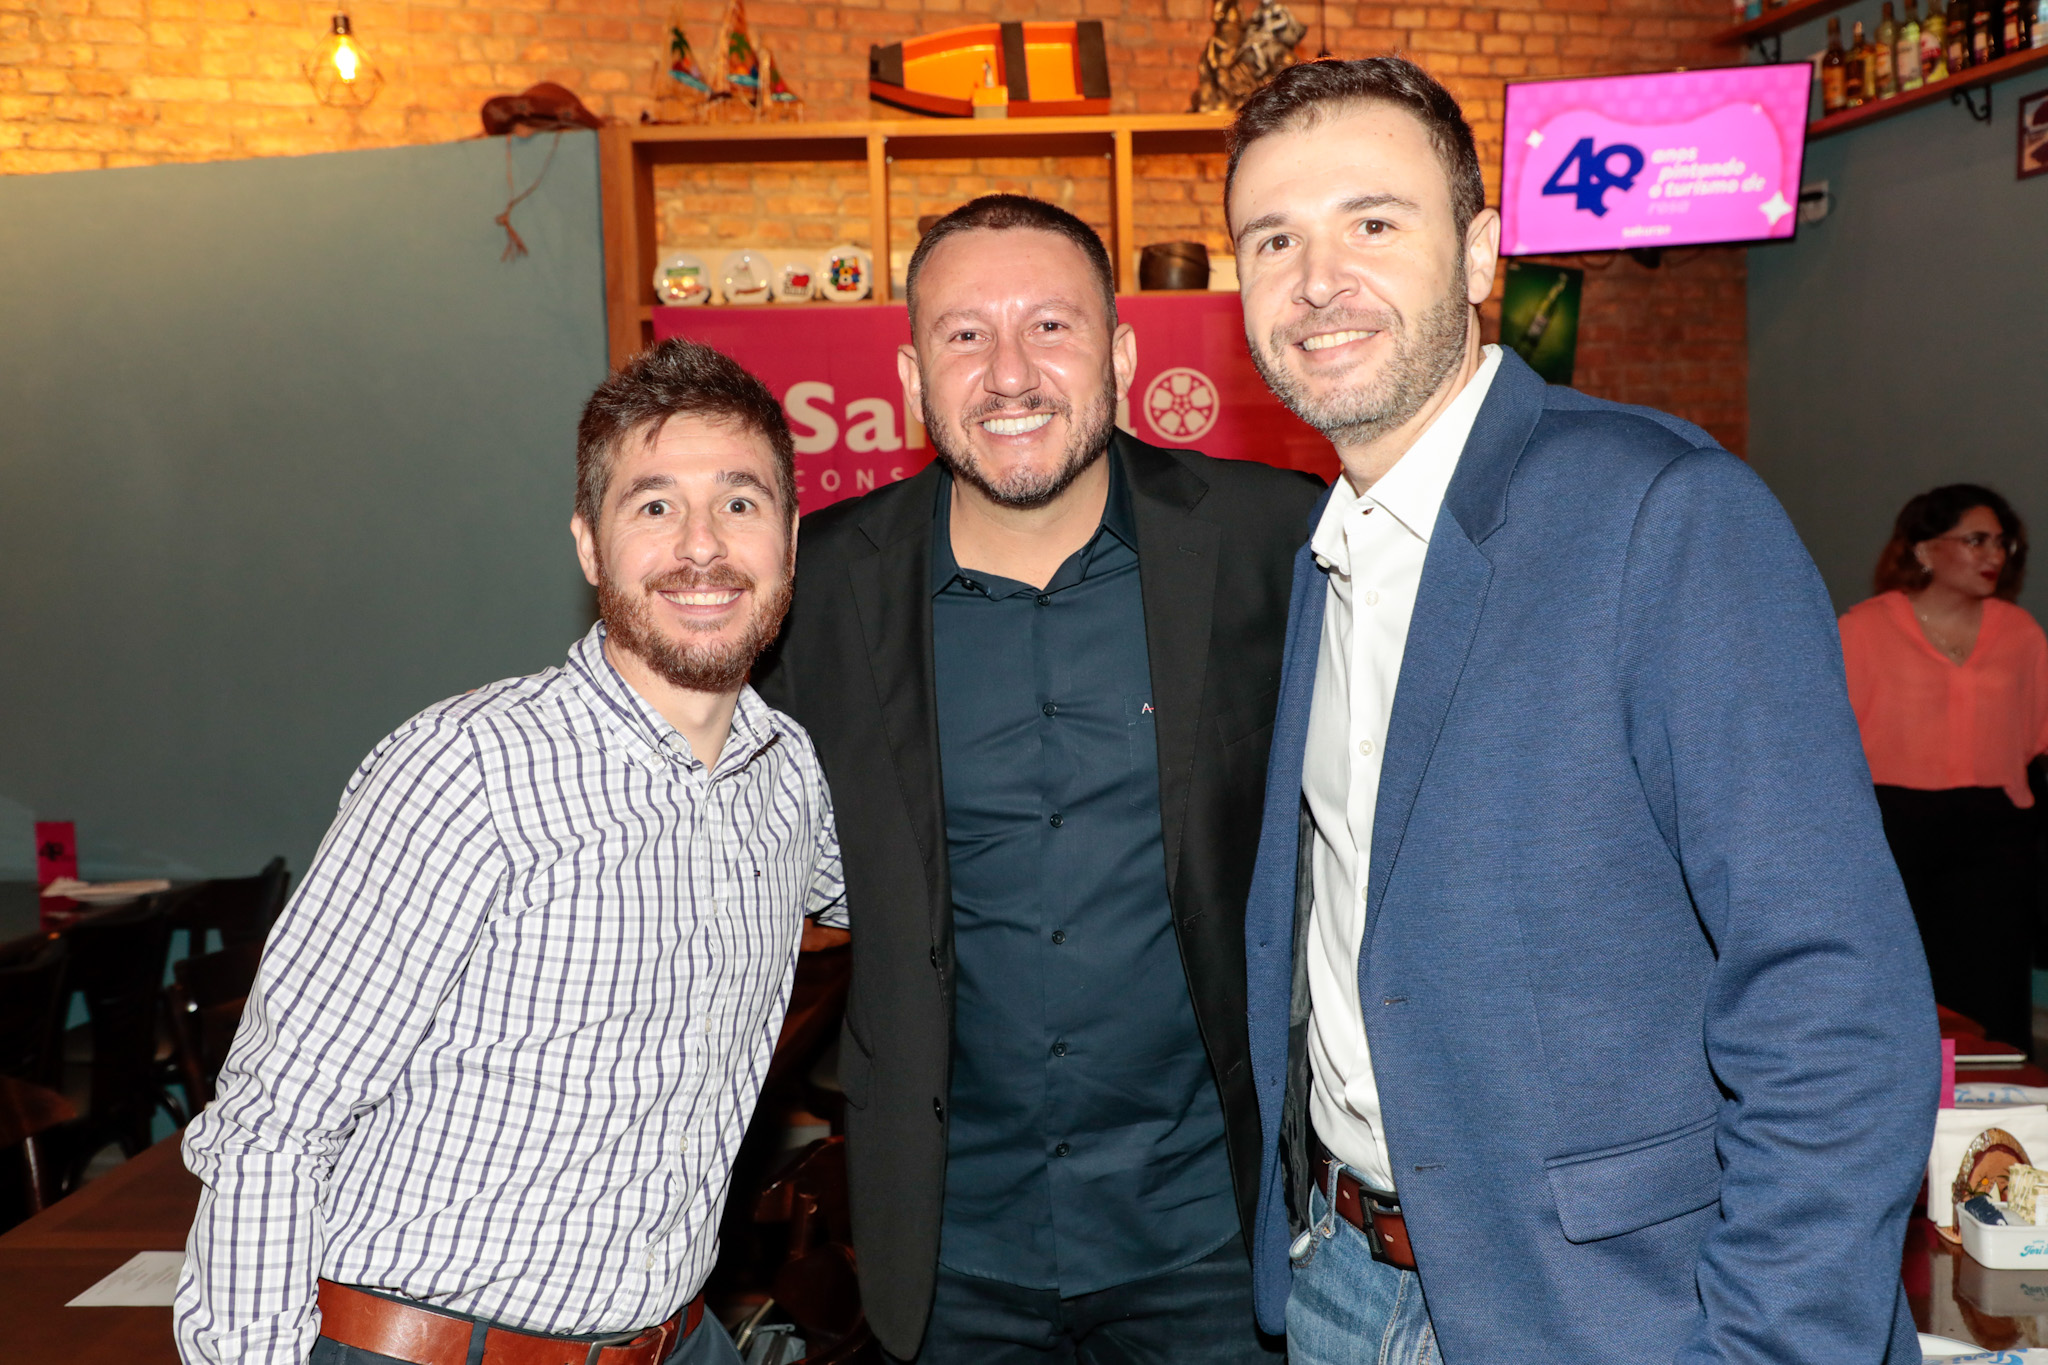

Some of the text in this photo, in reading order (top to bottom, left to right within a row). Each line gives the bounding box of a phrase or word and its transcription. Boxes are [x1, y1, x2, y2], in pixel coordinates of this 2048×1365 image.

[1651, 147, 1698, 164] anos
[1657, 157, 1746, 184] pintando
[1648, 172, 1766, 199] o turismo de
